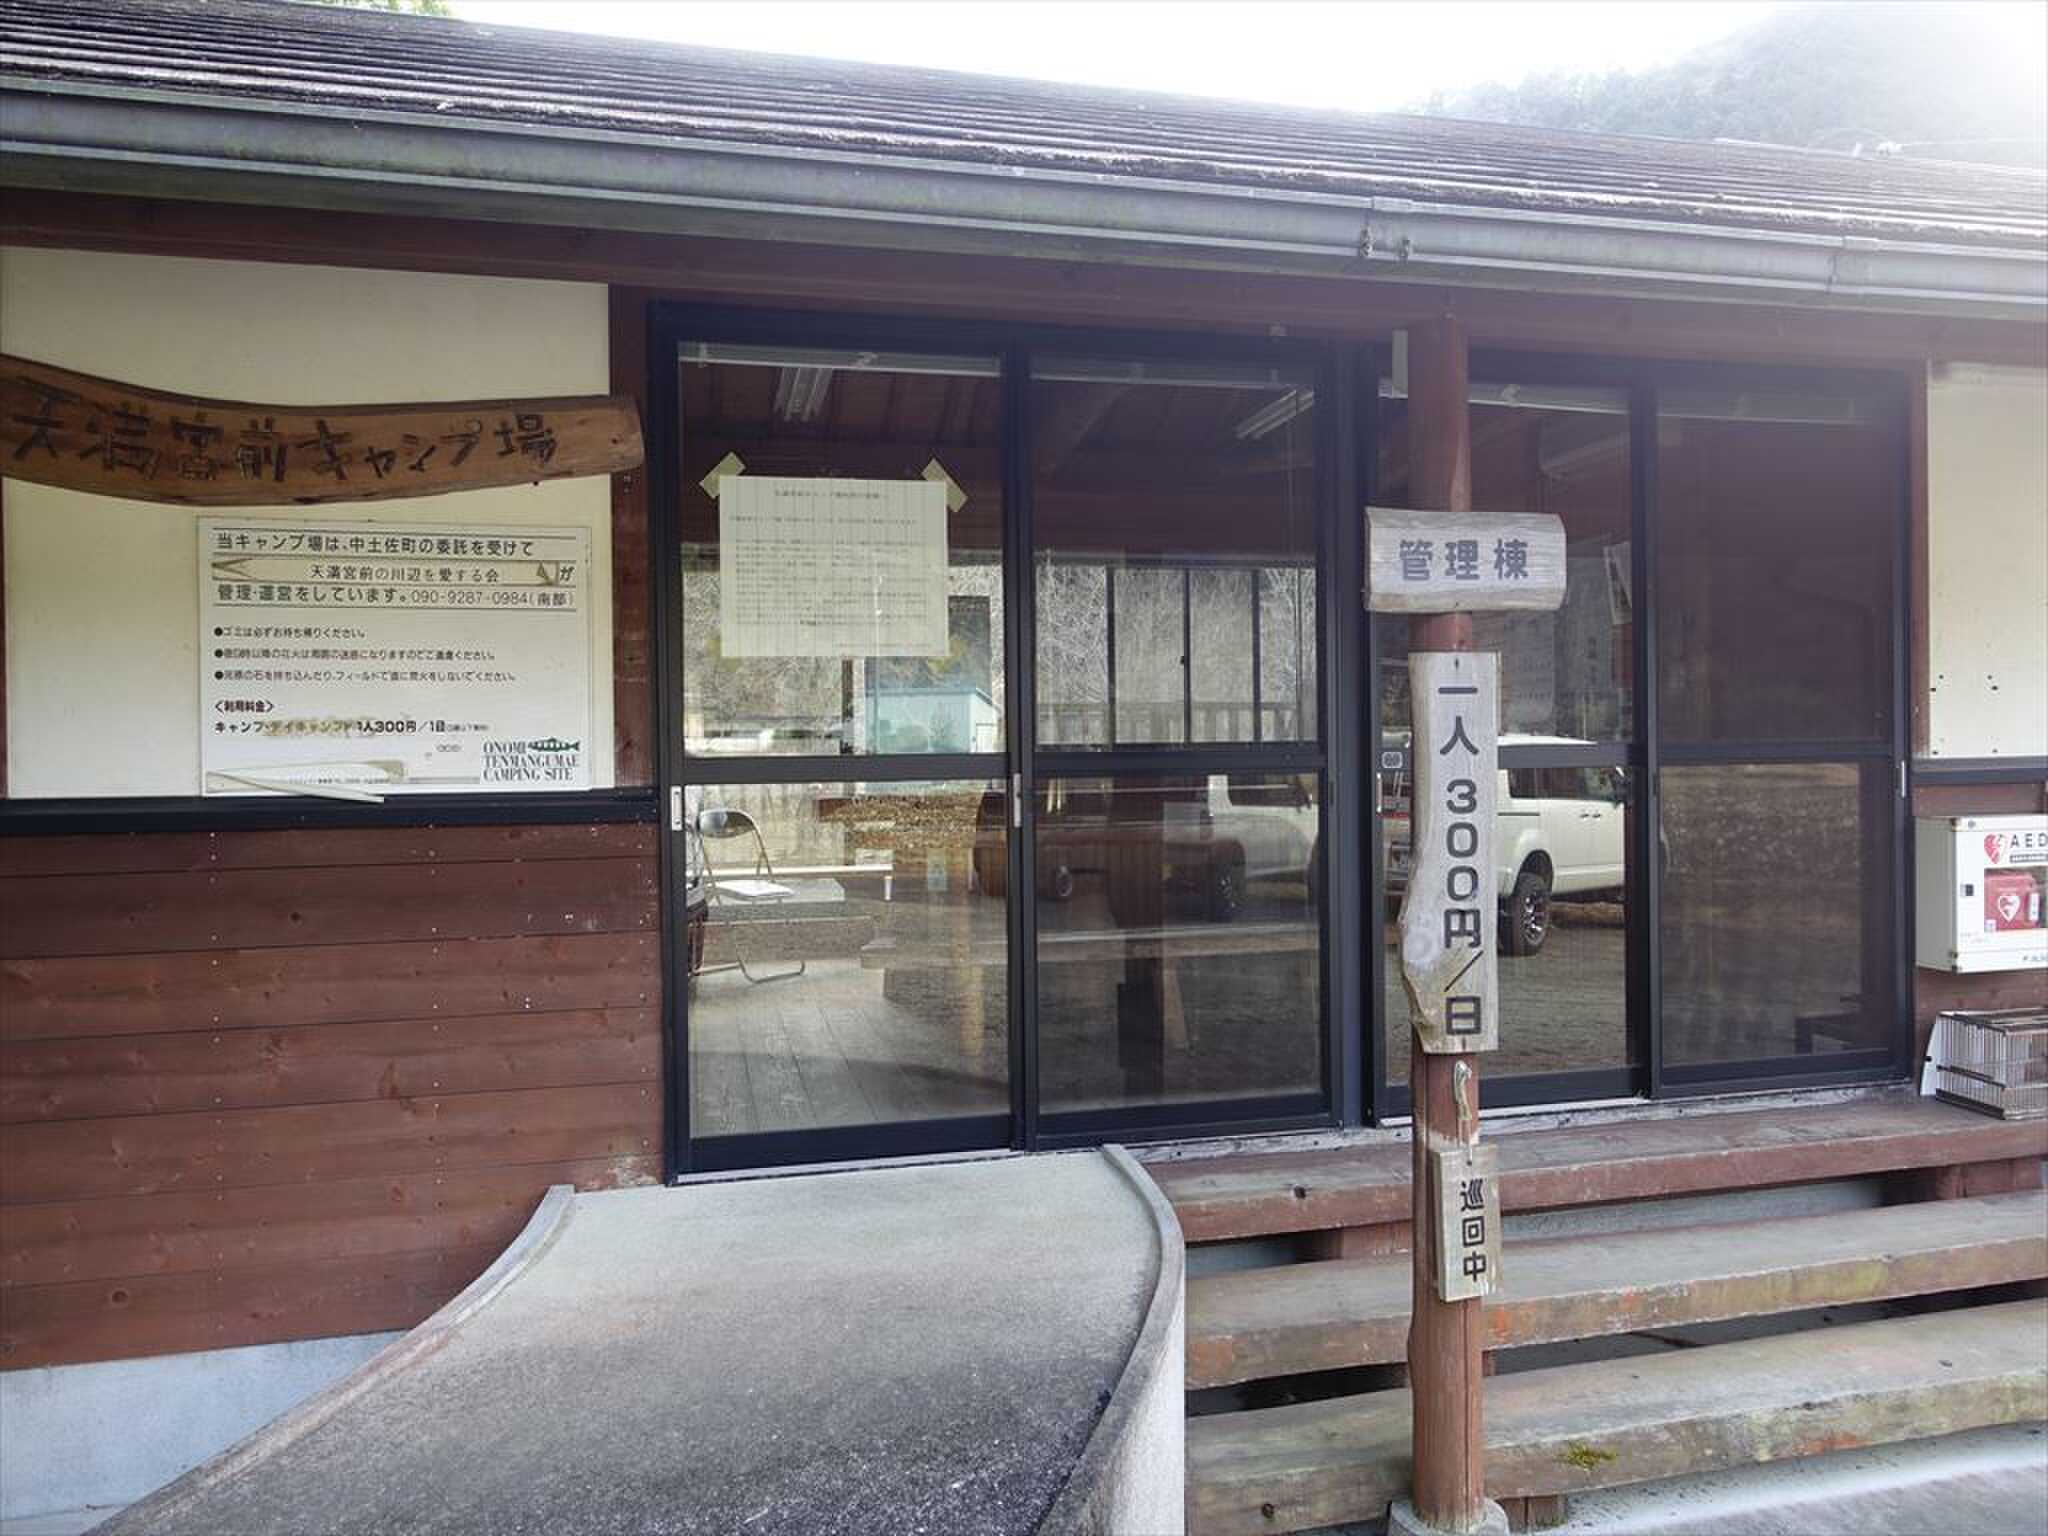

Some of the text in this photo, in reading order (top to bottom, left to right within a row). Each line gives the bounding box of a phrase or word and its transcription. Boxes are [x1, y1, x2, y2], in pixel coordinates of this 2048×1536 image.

[217, 532, 534, 556] 当キャンプ場は、中土佐町の委託を受けて
[1399, 538, 1530, 580] 管理棟
[310, 565, 499, 583] 天満宮前の川辺を愛する会
[483, 767, 574, 781] CAMPING SITE
[2010, 832, 2048, 848] AED
[1459, 1178, 1488, 1283] 巡回中
